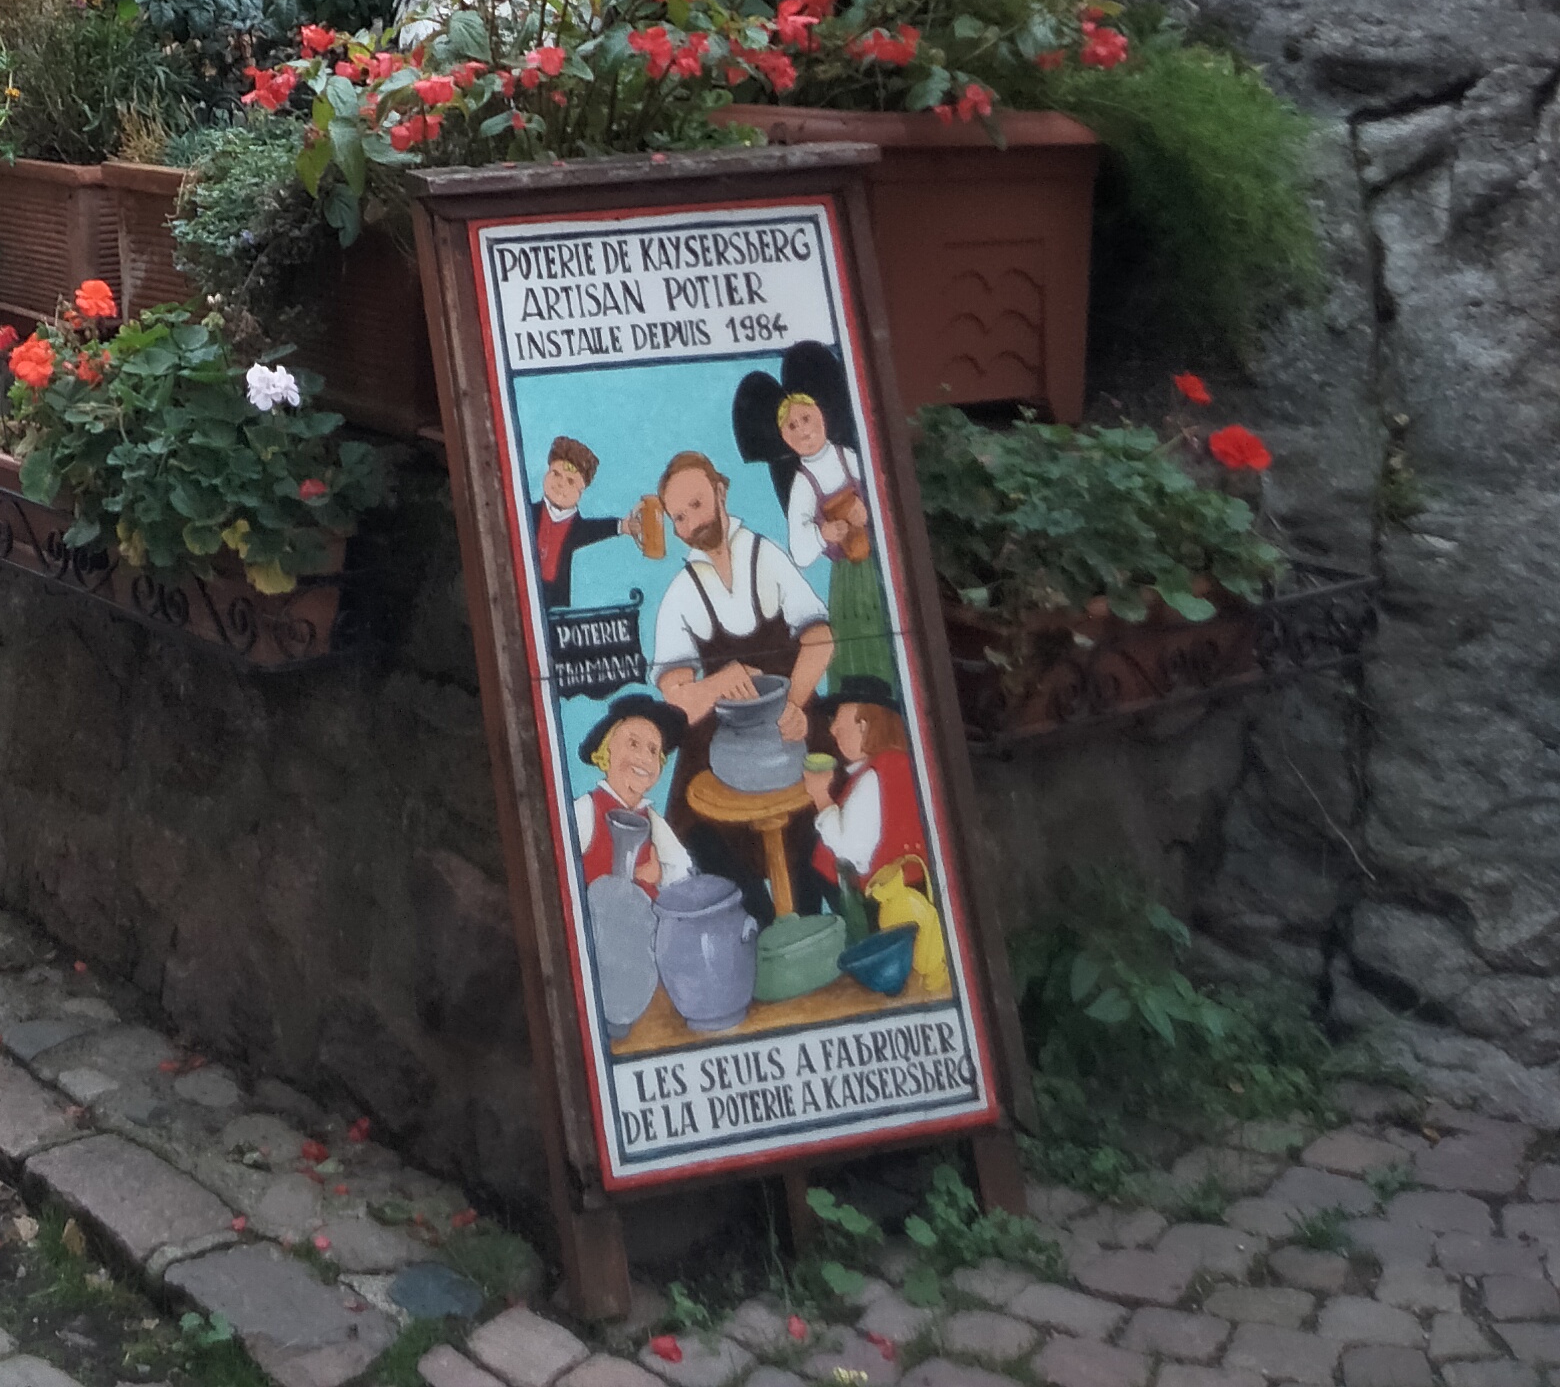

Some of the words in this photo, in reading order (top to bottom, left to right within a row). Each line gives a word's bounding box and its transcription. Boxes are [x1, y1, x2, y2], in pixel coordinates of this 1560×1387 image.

[495, 241, 596, 282] POTERIE
[601, 239, 632, 275] DE
[521, 279, 646, 322] ARTISAN
[662, 271, 769, 311] POTIER
[630, 318, 712, 351] DEPUIS
[725, 312, 789, 343] 1984
[556, 618, 631, 649] POTERIE
[632, 1063, 688, 1103] LES
[699, 1046, 785, 1093] SEULS
[796, 1042, 817, 1077] A
[621, 1107, 658, 1146] DE
[661, 1100, 700, 1139] LA
[707, 1083, 797, 1129] POTERIE
[801, 1079, 822, 1115] A
